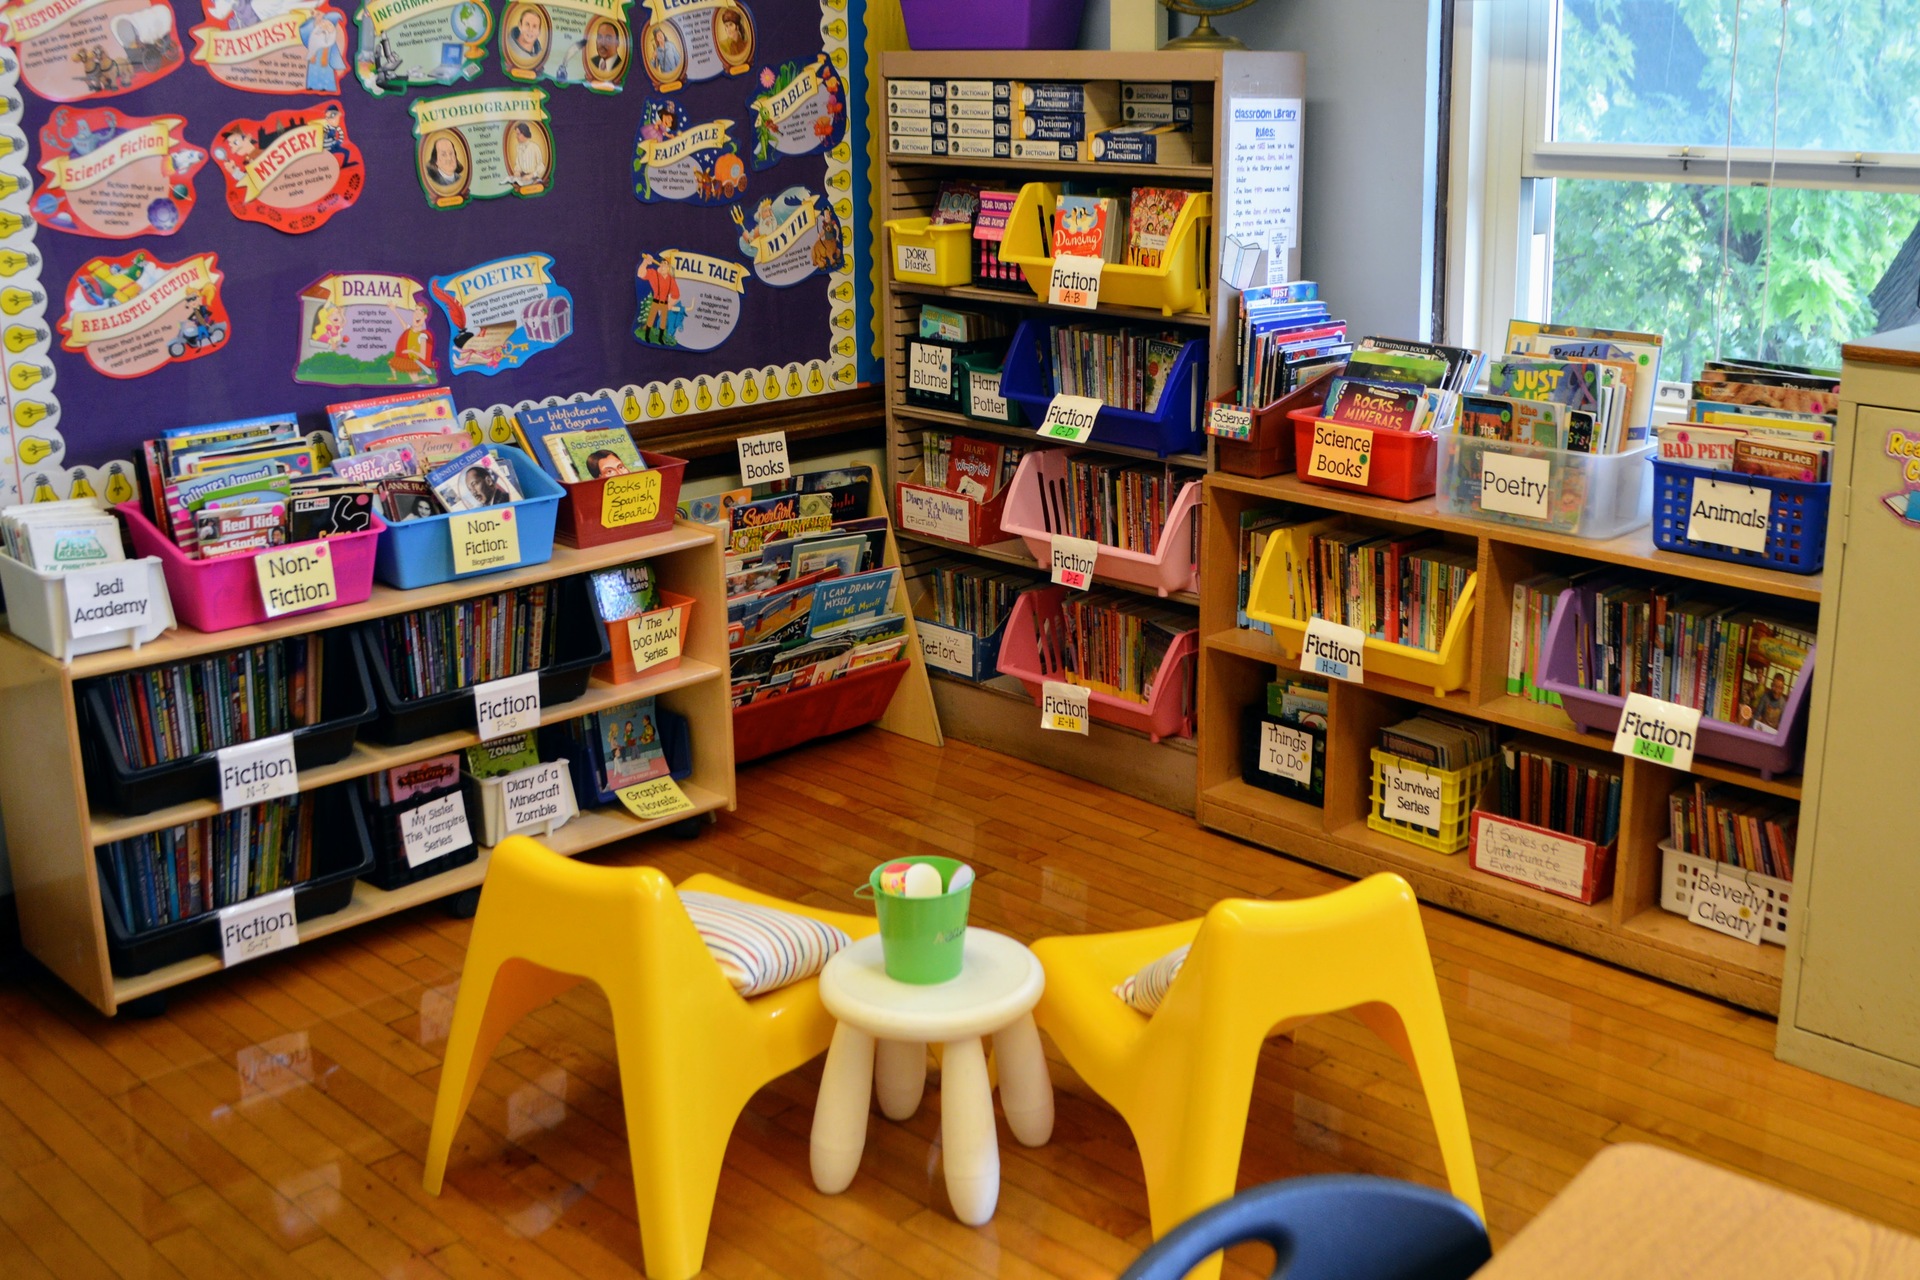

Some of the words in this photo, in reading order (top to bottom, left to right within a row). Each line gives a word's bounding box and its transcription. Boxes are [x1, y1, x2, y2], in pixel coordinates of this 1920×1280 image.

[213, 21, 297, 57] FANTASY
[772, 75, 814, 117] FABLE
[900, 88, 928, 97] DICTIONARY
[961, 88, 990, 97] DICTIONARY
[1035, 88, 1071, 99] Dictionary
[420, 100, 540, 124] AUTOBIOGRAPHY
[1036, 99, 1070, 109] Thesaurus
[900, 126, 929, 134] DICTIONARY
[961, 127, 990, 136] DICTIONARY
[1036, 119, 1072, 130] Dictionary
[1037, 129, 1071, 140] Thesaurus
[1255, 126, 1276, 138] Rules:
[654, 139, 689, 161] FAIRY
[690, 128, 720, 146] TALE
[1107, 141, 1144, 151] Dictionary
[65, 153, 115, 182] Science
[120, 134, 164, 158] Fiction
[254, 129, 318, 182] MYSTERY
[1107, 151, 1142, 161] Thesaurus
[767, 210, 809, 257] MYTH
[1055, 227, 1102, 250] Dancing
[905, 247, 929, 260] DORK
[673, 256, 704, 276] TALL
[708, 263, 739, 284] TALE
[904, 258, 932, 273] Diaries
[342, 280, 403, 299] DRAMA
[460, 262, 537, 296] POETRY
[1052, 268, 1098, 292] Fiction
[81, 295, 152, 333] REALISTIC
[150, 267, 199, 305] FICTION
[469, 300, 489, 310] writing
[501, 289, 526, 300] creatively
[489, 303, 508, 312] sounds
[519, 293, 544, 304] meanings
[1064, 290, 1081, 304] A-B
[1271, 287, 1289, 298] JUST
[480, 313, 500, 323] present
[501, 309, 515, 317] ideas
[917, 346, 945, 370] Judy
[1375, 340, 1409, 352] EYEWITNESS
[1409, 345, 1430, 355] BOOKS
[913, 369, 948, 390] Blume
[1513, 368, 1564, 391] JUST
[973, 396, 1006, 414] Potter
[1353, 393, 1394, 414] ROCKS
[526, 411, 545, 425] La
[547, 404, 608, 421] bibliotecaria
[550, 420, 562, 432] de
[565, 416, 612, 430] Basora
[1047, 405, 1093, 429] Fiction
[1213, 408, 1251, 427] Science
[1344, 408, 1403, 431] MINERALS
[570, 434, 627, 451] Sacagawea?
[742, 439, 784, 458] Picture
[963, 443, 987, 456] DIARY
[1315, 427, 1371, 455] Science
[1662, 442, 1694, 460] BAD
[1697, 442, 1735, 461] PETS
[432, 462, 460, 483] KENNETH
[465, 449, 484, 465] DAVIS
[1316, 454, 1363, 479] Books
[1750, 446, 1780, 460] PUPPY
[1782, 452, 1812, 466] PLACE
[340, 458, 377, 480] GABBY
[746, 459, 785, 479] Books
[179, 479, 226, 508] Cultures
[228, 464, 271, 487] Around
[606, 479, 641, 496] Books
[645, 476, 657, 488] in
[1482, 470, 1547, 505] Poetry
[611, 492, 654, 511] Spanish
[905, 490, 924, 510] Diary
[924, 496, 934, 509] of
[941, 500, 964, 521] Wimpy
[221, 518, 250, 533] Real
[252, 514, 280, 528] Kids
[607, 503, 657, 524] (Español)
[927, 507, 942, 521] Kid
[1692, 499, 1766, 529] Animals
[467, 518, 501, 535] Non-
[465, 539, 509, 556] Fiction:
[268, 556, 319, 579] Non-
[471, 554, 505, 567] Biographies
[1053, 549, 1094, 576] Fiction
[626, 566, 649, 584] MAN
[93, 577, 124, 598] Jedi
[269, 582, 330, 610] Fiction
[829, 585, 846, 598] CAN
[848, 582, 873, 594] DRAW
[874, 580, 886, 590] IT
[74, 598, 148, 624] Academy
[824, 595, 853, 611] MYSELF
[858, 597, 881, 611] Myself
[645, 618, 662, 630] The
[633, 634, 653, 651] DOG
[654, 627, 678, 644] MAN
[643, 646, 669, 663] Series
[1304, 633, 1361, 667] Fiction
[1321, 660, 1341, 676] H-L
[478, 693, 538, 723] Fiction
[1044, 695, 1088, 720] Fiction
[1057, 716, 1075, 730] E-H
[1621, 710, 1693, 751] Fiction
[1267, 726, 1307, 752] Things
[1638, 739, 1666, 760] M-N
[487, 742, 526, 760] ZOMBIE
[1269, 747, 1284, 766] To
[1287, 753, 1304, 772] Do
[223, 757, 294, 791] Fiction
[506, 775, 535, 794] Diary
[537, 770, 548, 784] of
[246, 782, 270, 798] N-P
[509, 783, 560, 810] Minecraft
[626, 782, 672, 801] Graphic
[1393, 777, 1440, 801] Survived
[636, 794, 680, 812] Novels:
[1397, 796, 1430, 817] Series
[411, 813, 426, 828] My
[428, 803, 454, 821] Sister
[515, 804, 558, 825] Zombie
[405, 829, 424, 845] The
[424, 815, 466, 834] Vampire
[1485, 822, 1494, 840] A
[1499, 827, 1537, 850] Series
[1541, 842, 1561, 856] of
[424, 833, 453, 853] Series
[1485, 839, 1561, 873] Unfortunate
[1489, 856, 1527, 877] Events
[1698, 872, 1766, 914] Beverly
[224, 911, 295, 948] Fiction
[1697, 900, 1757, 939] Cleary
